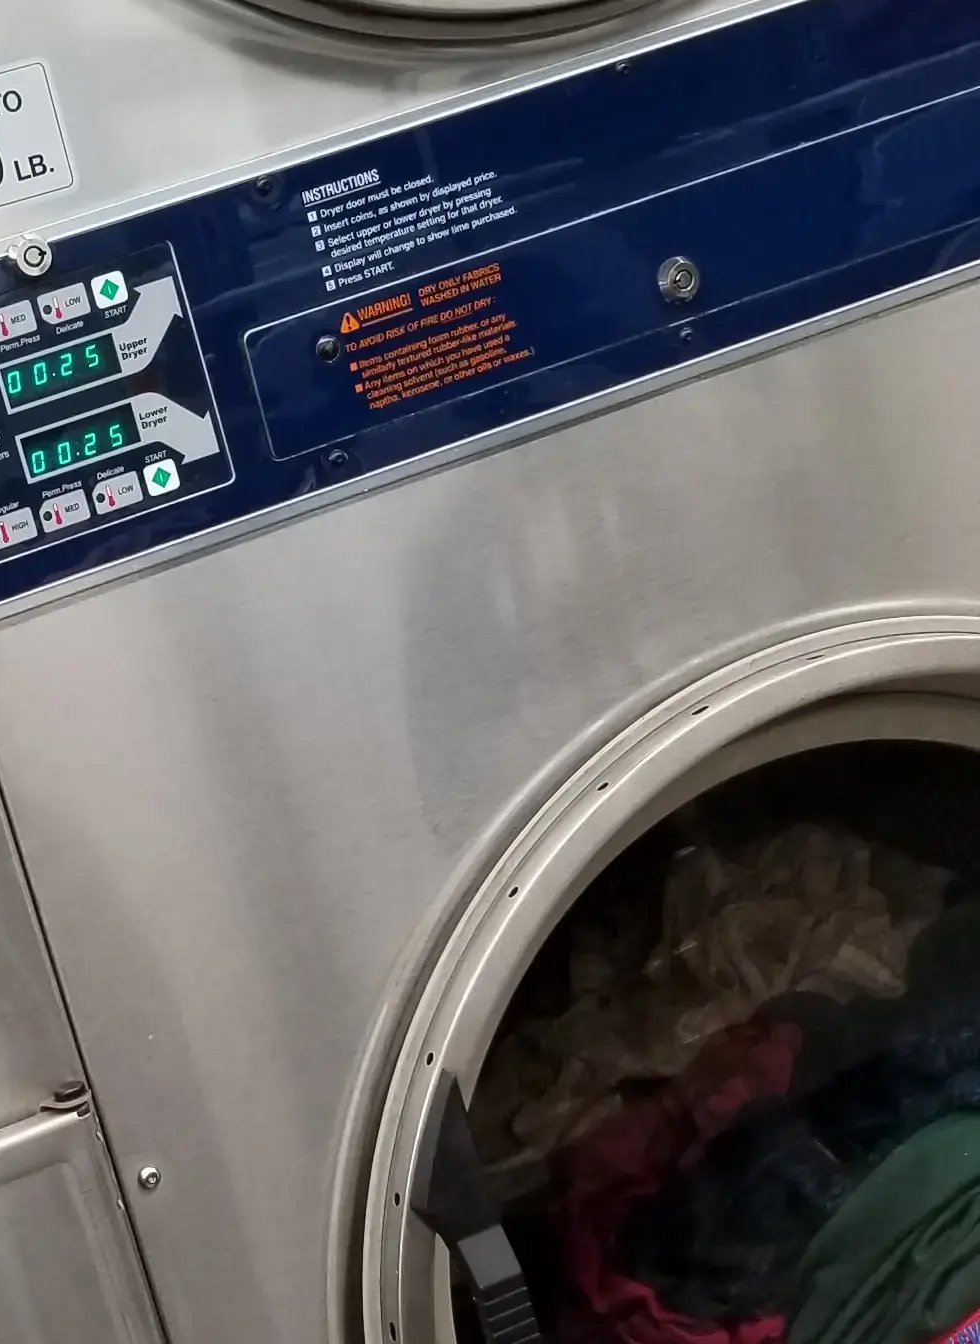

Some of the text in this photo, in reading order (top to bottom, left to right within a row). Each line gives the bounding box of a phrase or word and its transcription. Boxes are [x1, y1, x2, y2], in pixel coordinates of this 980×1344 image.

[13, 154, 55, 182] LB.
[302, 169, 379, 203] INSTRUCTIONS
[319, 204, 344, 218] Dryer
[345, 197, 365, 209] door
[367, 188, 389, 202] must
[390, 185, 402, 195] be
[403, 174, 434, 191] closed.
[323, 217, 349, 232] Insert
[350, 210, 377, 224] coins,
[378, 206, 388, 215] as
[390, 196, 418, 211] shown
[418, 191, 430, 202] by
[432, 177, 472, 197] displayed
[473, 171, 497, 185] price.
[327, 231, 355, 247] Select
[355, 223, 381, 238] upper
[382, 219, 392, 229] or
[393, 211, 417, 225] lower
[418, 203, 441, 217] dryer
[442, 200, 453, 210] by
[455, 187, 491, 207] pressing
[330, 195, 503, 258] desired temperature setting for that dryer.
[334, 256, 365, 272] Display
[366, 249, 382, 261] will
[383, 240, 415, 256] change
[415, 237, 425, 245] to
[426, 228, 449, 242] show
[450, 222, 470, 234] time
[471, 206, 517, 229] purchased.
[337, 273, 363, 287] Press
[363, 261, 394, 278] START.
[418, 262, 499, 297] DRY ONLY FABRICS
[420, 273, 501, 306] WASHED IN WATER
[10, 314, 26, 324] MED
[64, 295, 81, 307] LOW
[55, 320, 84, 334] Delicate
[104, 304, 126, 318] START
[357, 294, 410, 320] WARNING!
[345, 341, 357, 352] TO
[358, 333, 385, 348] AVOID
[385, 326, 405, 339] RISK
[406, 320, 419, 332] OF
[439, 309, 453, 321] DO
[454, 302, 472, 316] NOT
[118, 337, 147, 354] Upper
[121, 346, 147, 360] Dryer
[138, 406, 167, 420] Lower
[141, 415, 167, 429] Dryer
[96, 466, 124, 480] Delicate
[144, 449, 166, 463] START
[11, 484, 133, 531] HIGH MED LOW
